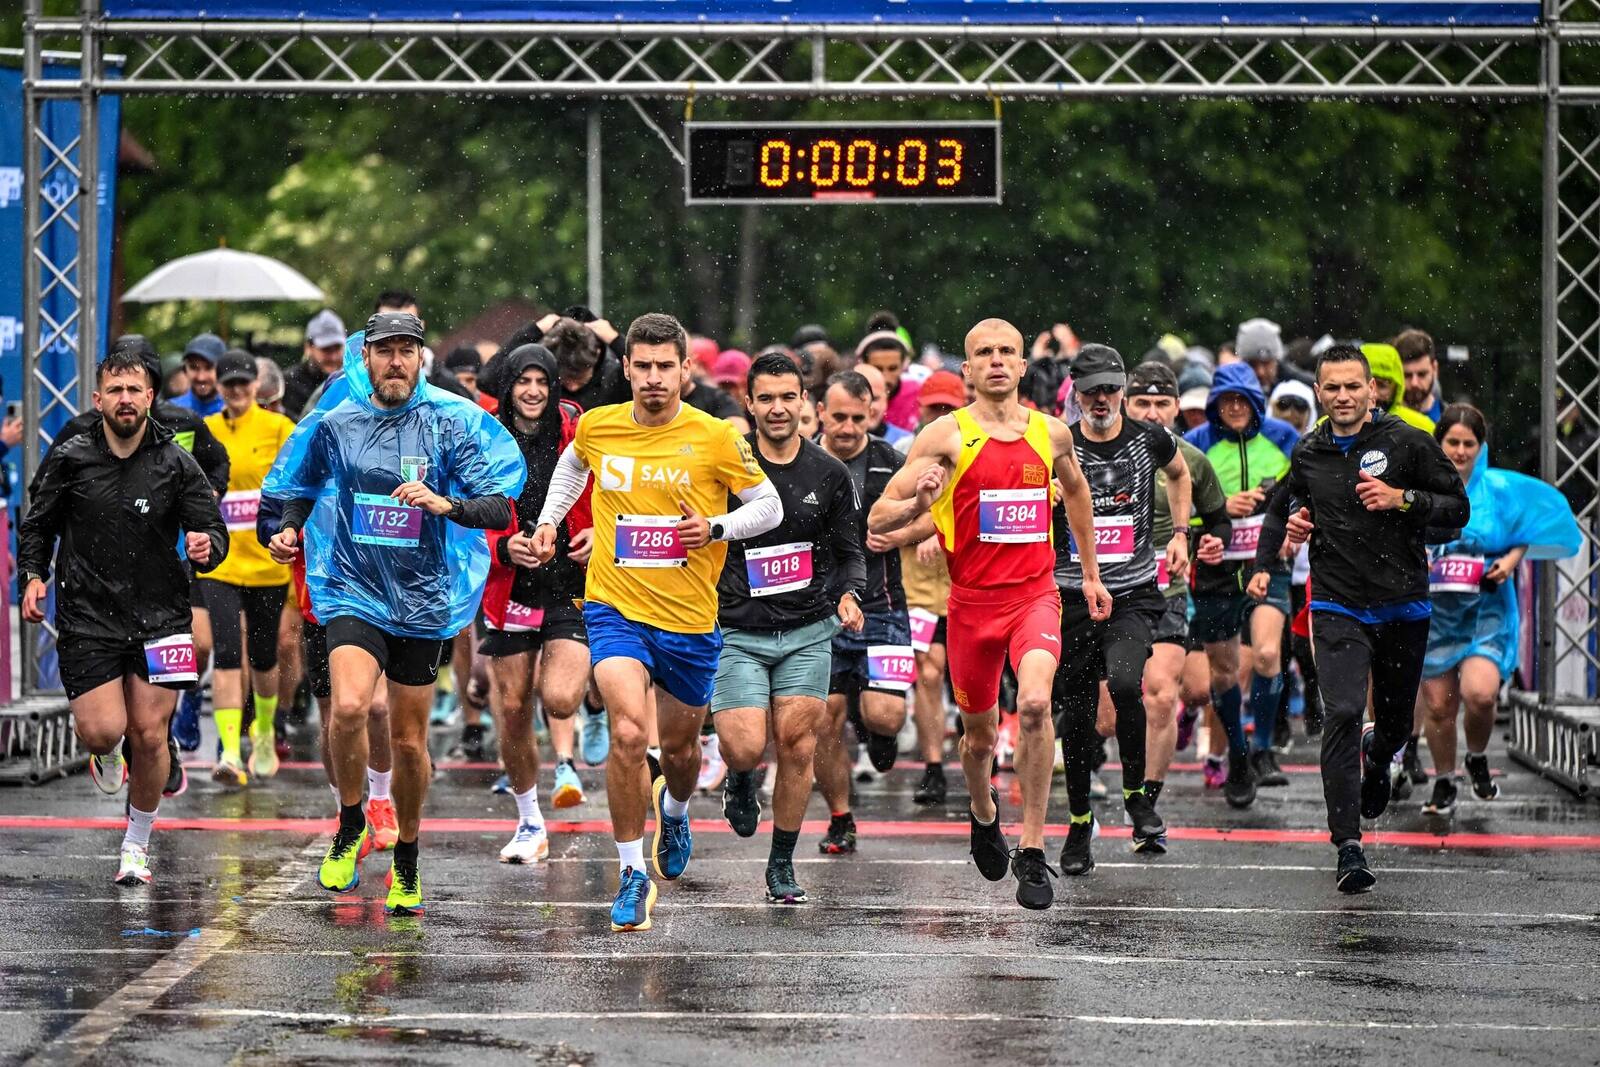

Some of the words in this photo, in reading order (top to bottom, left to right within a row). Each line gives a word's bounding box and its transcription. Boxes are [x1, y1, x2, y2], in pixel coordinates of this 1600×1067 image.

[760, 139, 964, 187] 0:00:03
[640, 464, 692, 486] SAVA
[367, 509, 409, 527] 1132
[995, 504, 1037, 522] 1304
[630, 530, 674, 547] 1286
[761, 556, 800, 577] 1018
[1440, 562, 1473, 577] 1221
[160, 647, 193, 664] 1279
[881, 658, 914, 674] 1198
